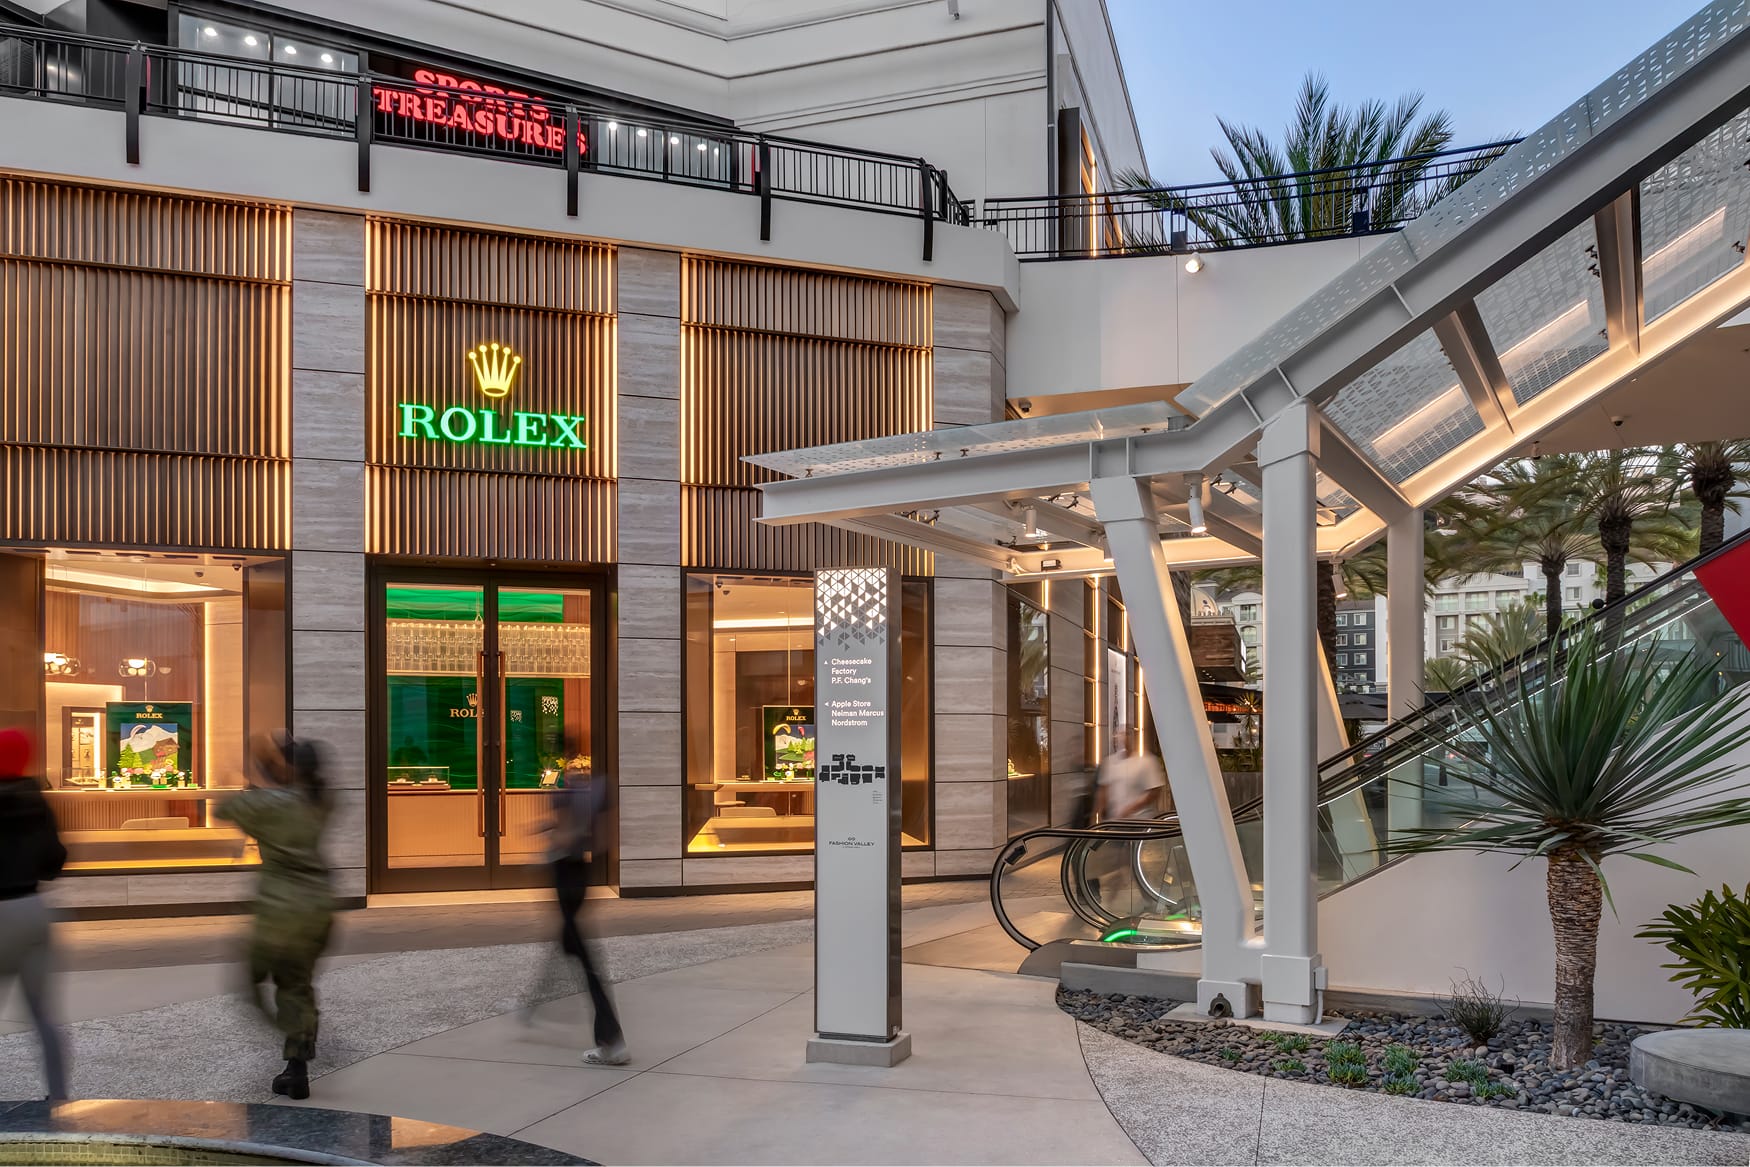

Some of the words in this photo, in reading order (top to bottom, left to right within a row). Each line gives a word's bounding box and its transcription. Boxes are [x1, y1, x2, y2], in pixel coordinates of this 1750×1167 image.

[414, 69, 550, 121] SPORTS
[372, 87, 587, 155] TREASURES
[398, 403, 588, 449] ROLEX
[831, 657, 872, 665] Cheesecake
[831, 667, 857, 675] Factory
[844, 677, 872, 685] Chang's
[831, 700, 852, 708] Apple
[449, 708, 485, 718] ROL
